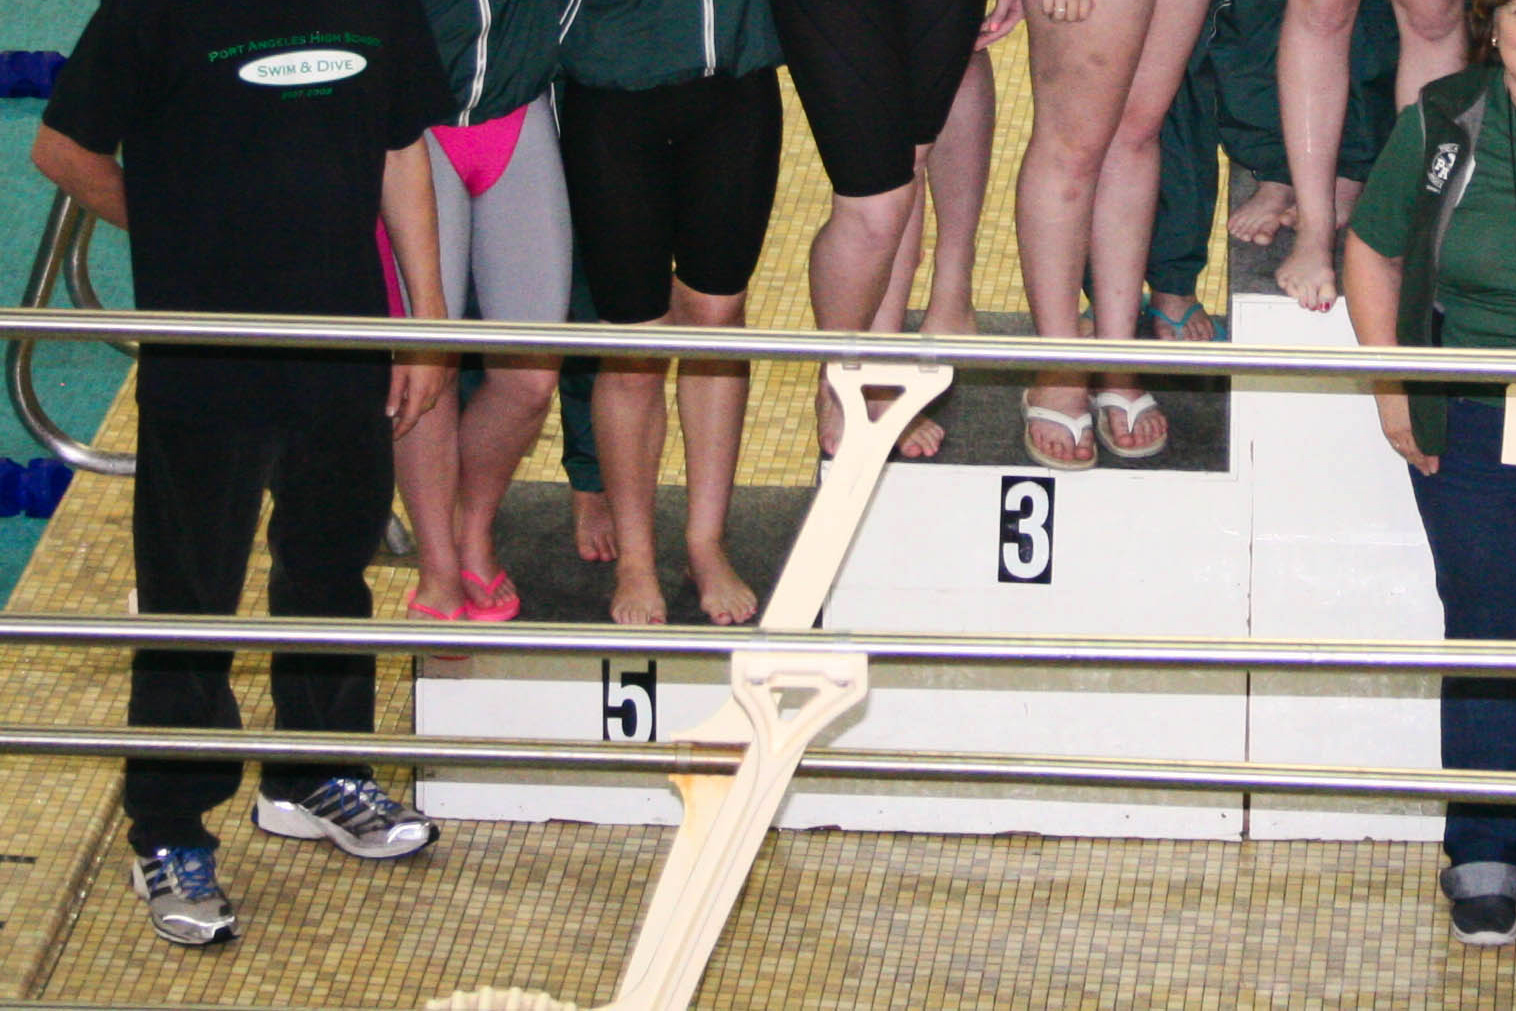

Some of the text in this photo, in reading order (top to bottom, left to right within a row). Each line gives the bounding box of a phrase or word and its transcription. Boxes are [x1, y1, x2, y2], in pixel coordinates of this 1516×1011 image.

[207, 43, 246, 63] PORT
[247, 35, 307, 52] ANGELES
[309, 31, 342, 44] HIGH
[256, 59, 353, 78] SWIM & DIVE
[1002, 480, 1050, 579] 3
[606, 659, 653, 742] 5
